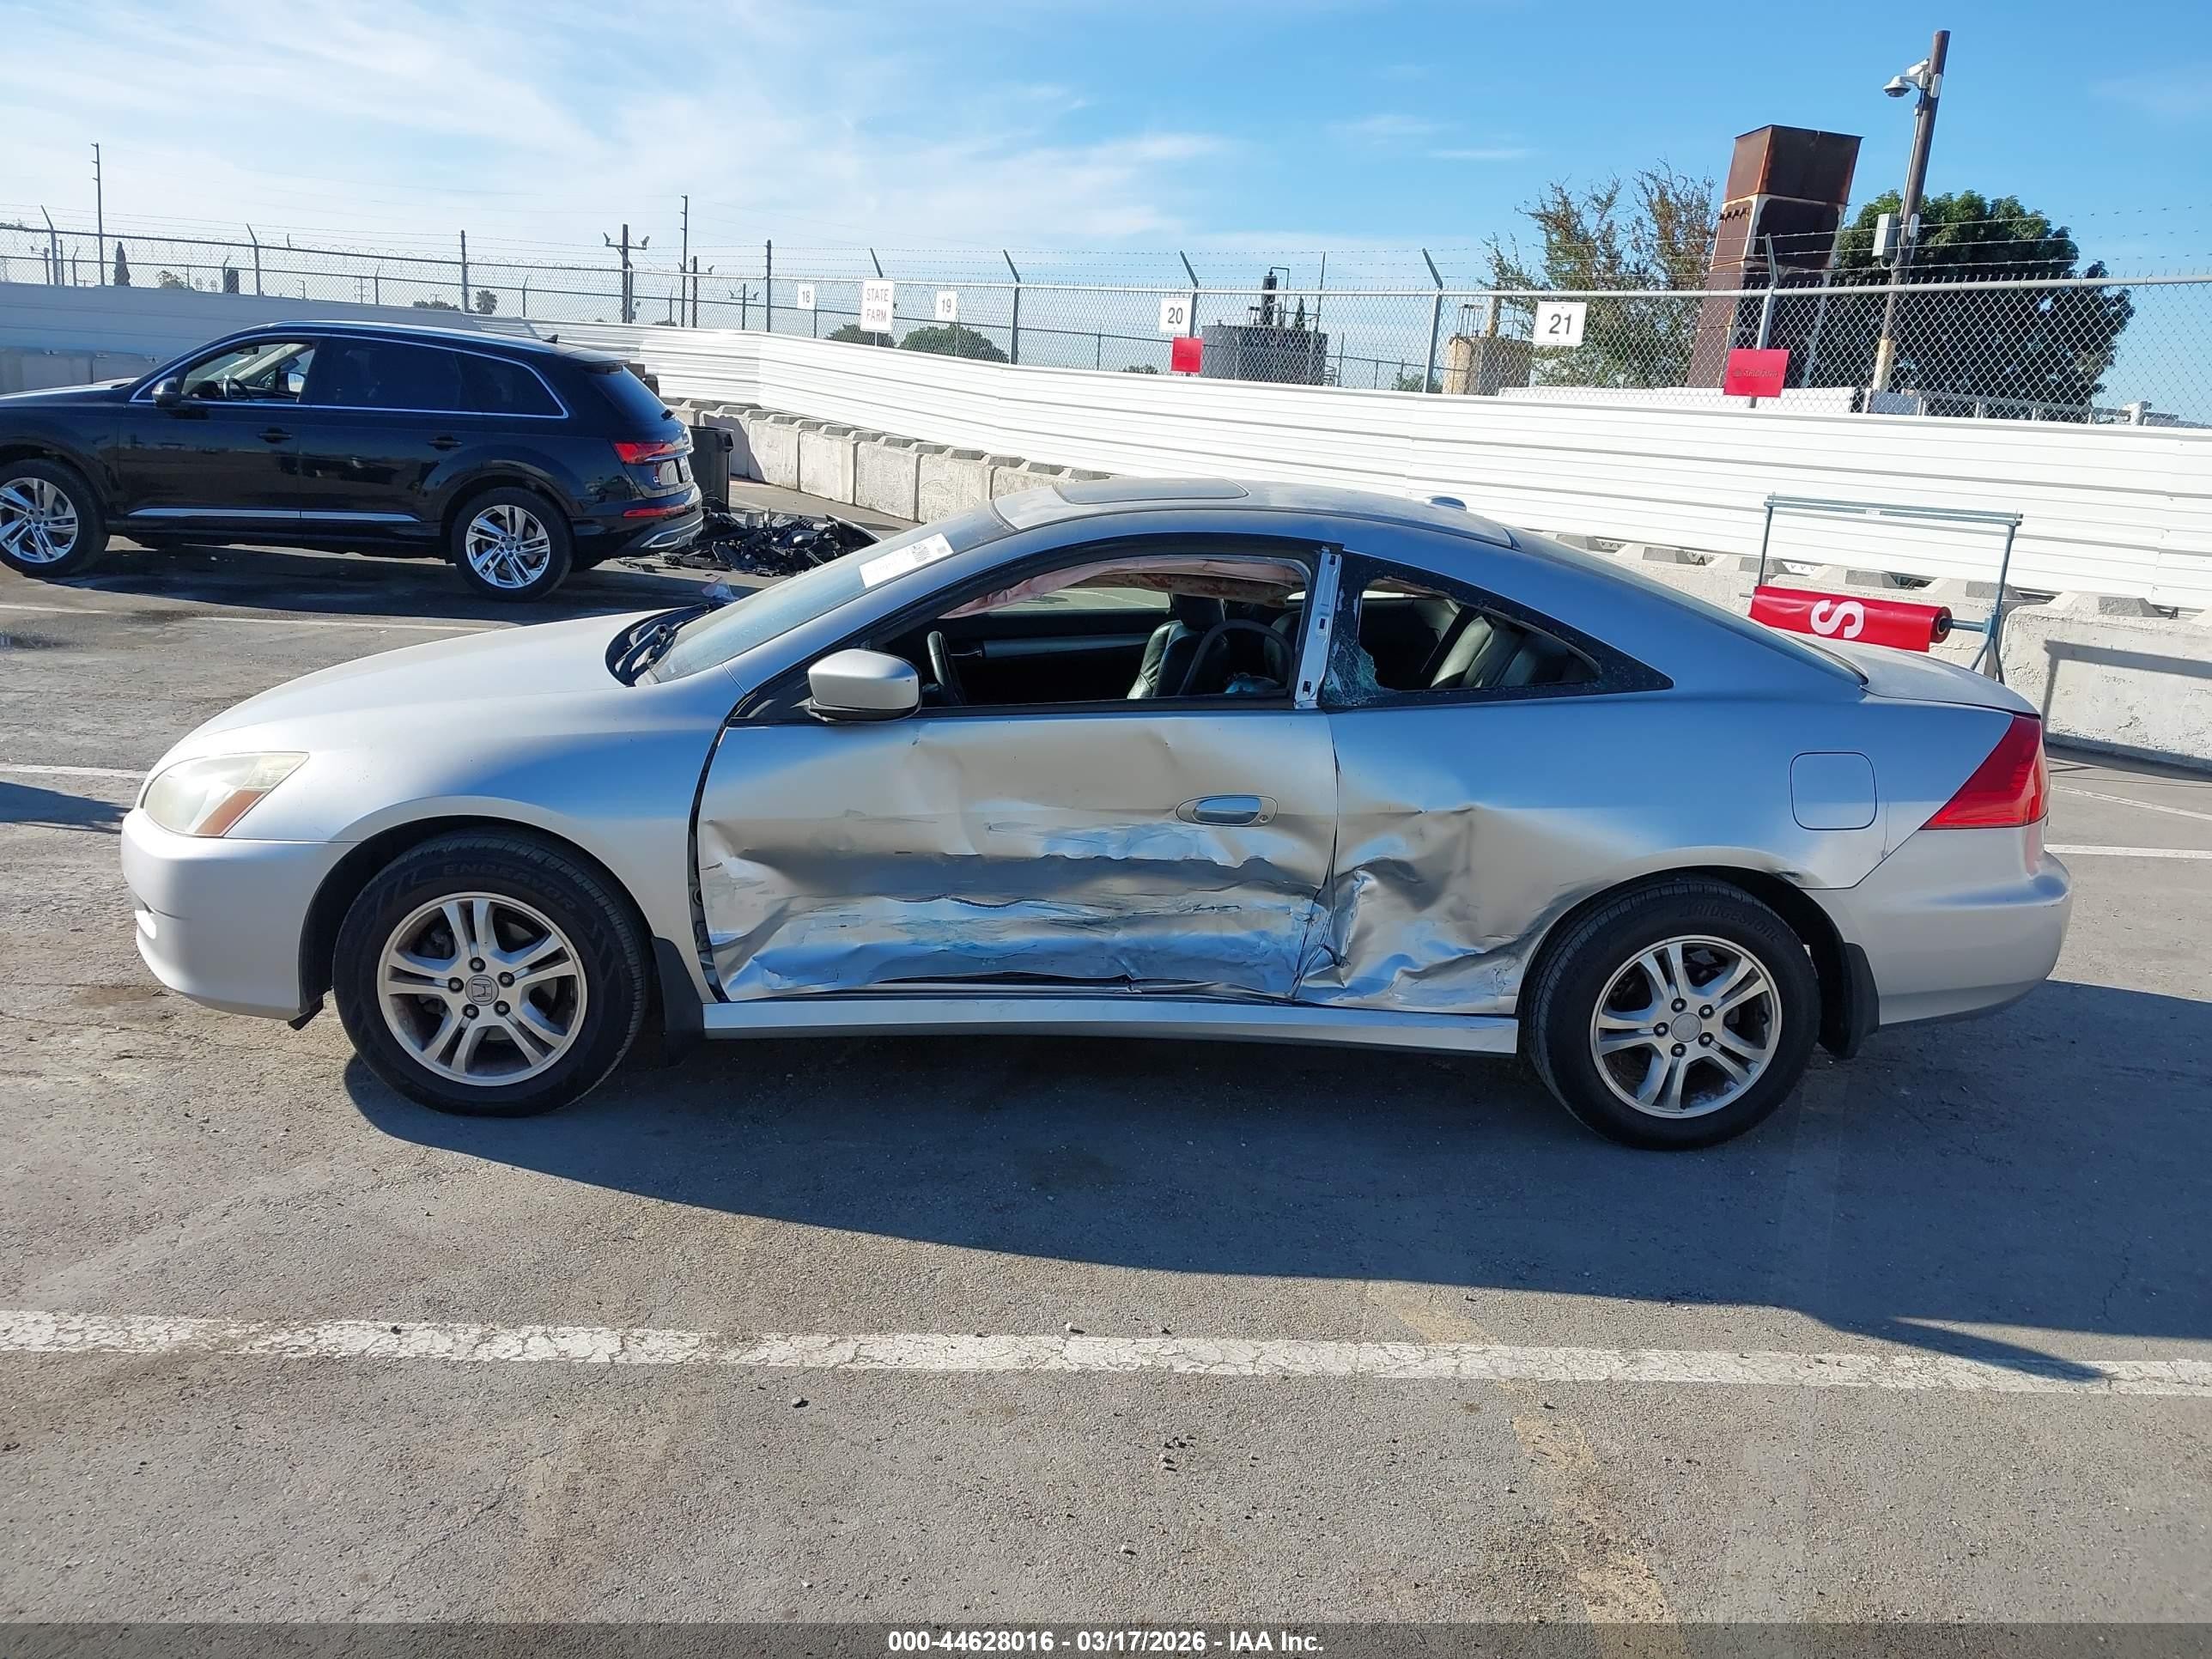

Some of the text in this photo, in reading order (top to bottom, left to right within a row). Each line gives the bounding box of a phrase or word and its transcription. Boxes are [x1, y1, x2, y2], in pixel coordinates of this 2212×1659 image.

[802, 290, 811, 303] 18
[866, 289, 889, 303] STATE
[942, 298, 951, 313] 19
[866, 307, 886, 323] FARM
[1168, 307, 1182, 325] 20
[1548, 313, 1572, 335] 21
[1810, 599, 1865, 639] S
